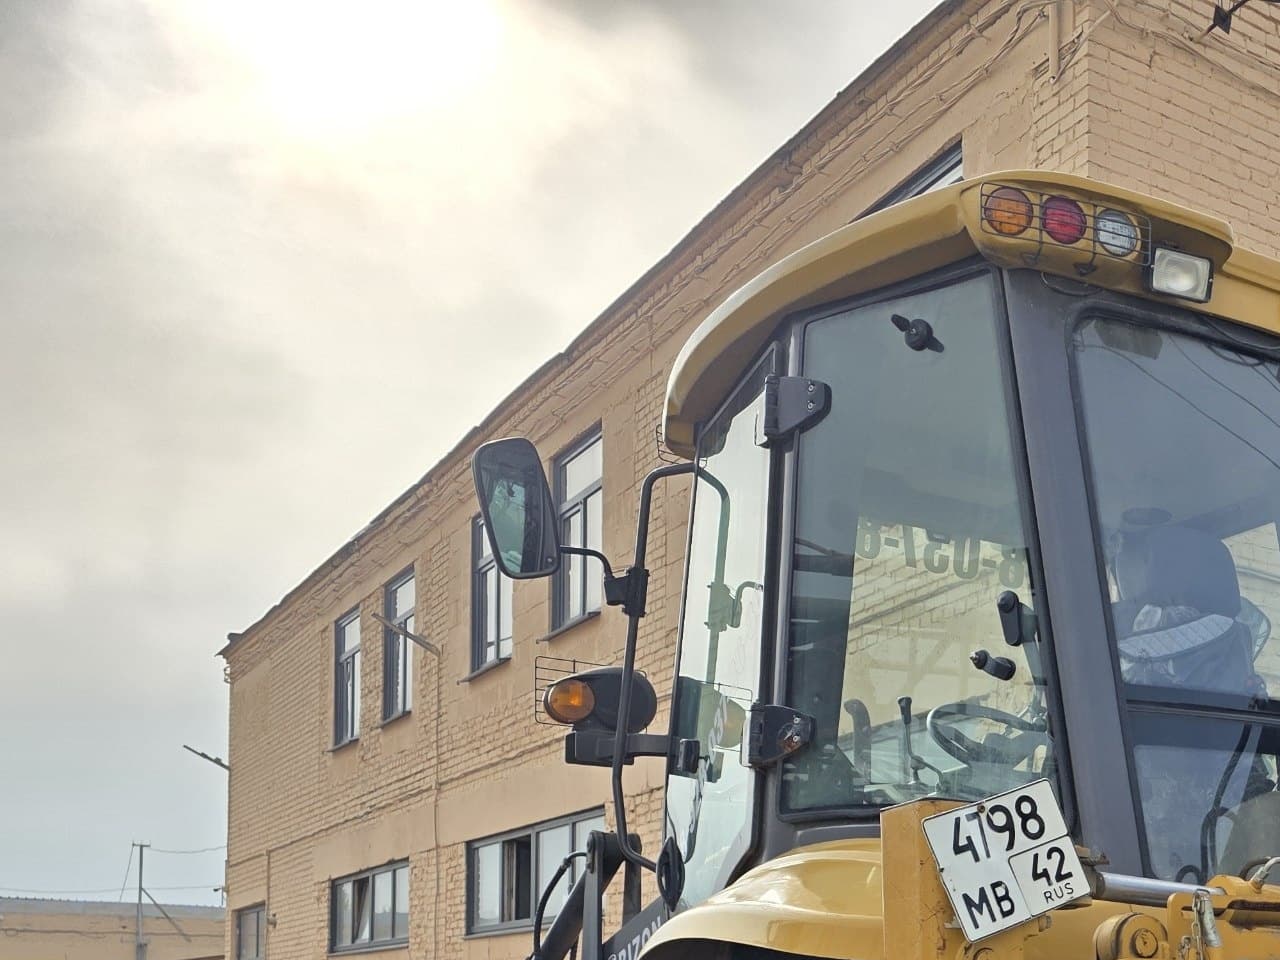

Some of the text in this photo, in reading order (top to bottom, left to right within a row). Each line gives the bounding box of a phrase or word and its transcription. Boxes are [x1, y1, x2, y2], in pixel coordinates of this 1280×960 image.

[952, 795, 1046, 863] 4798
[1031, 846, 1074, 887] 42
[962, 881, 1016, 930] MB
[1043, 882, 1074, 904] RUS
